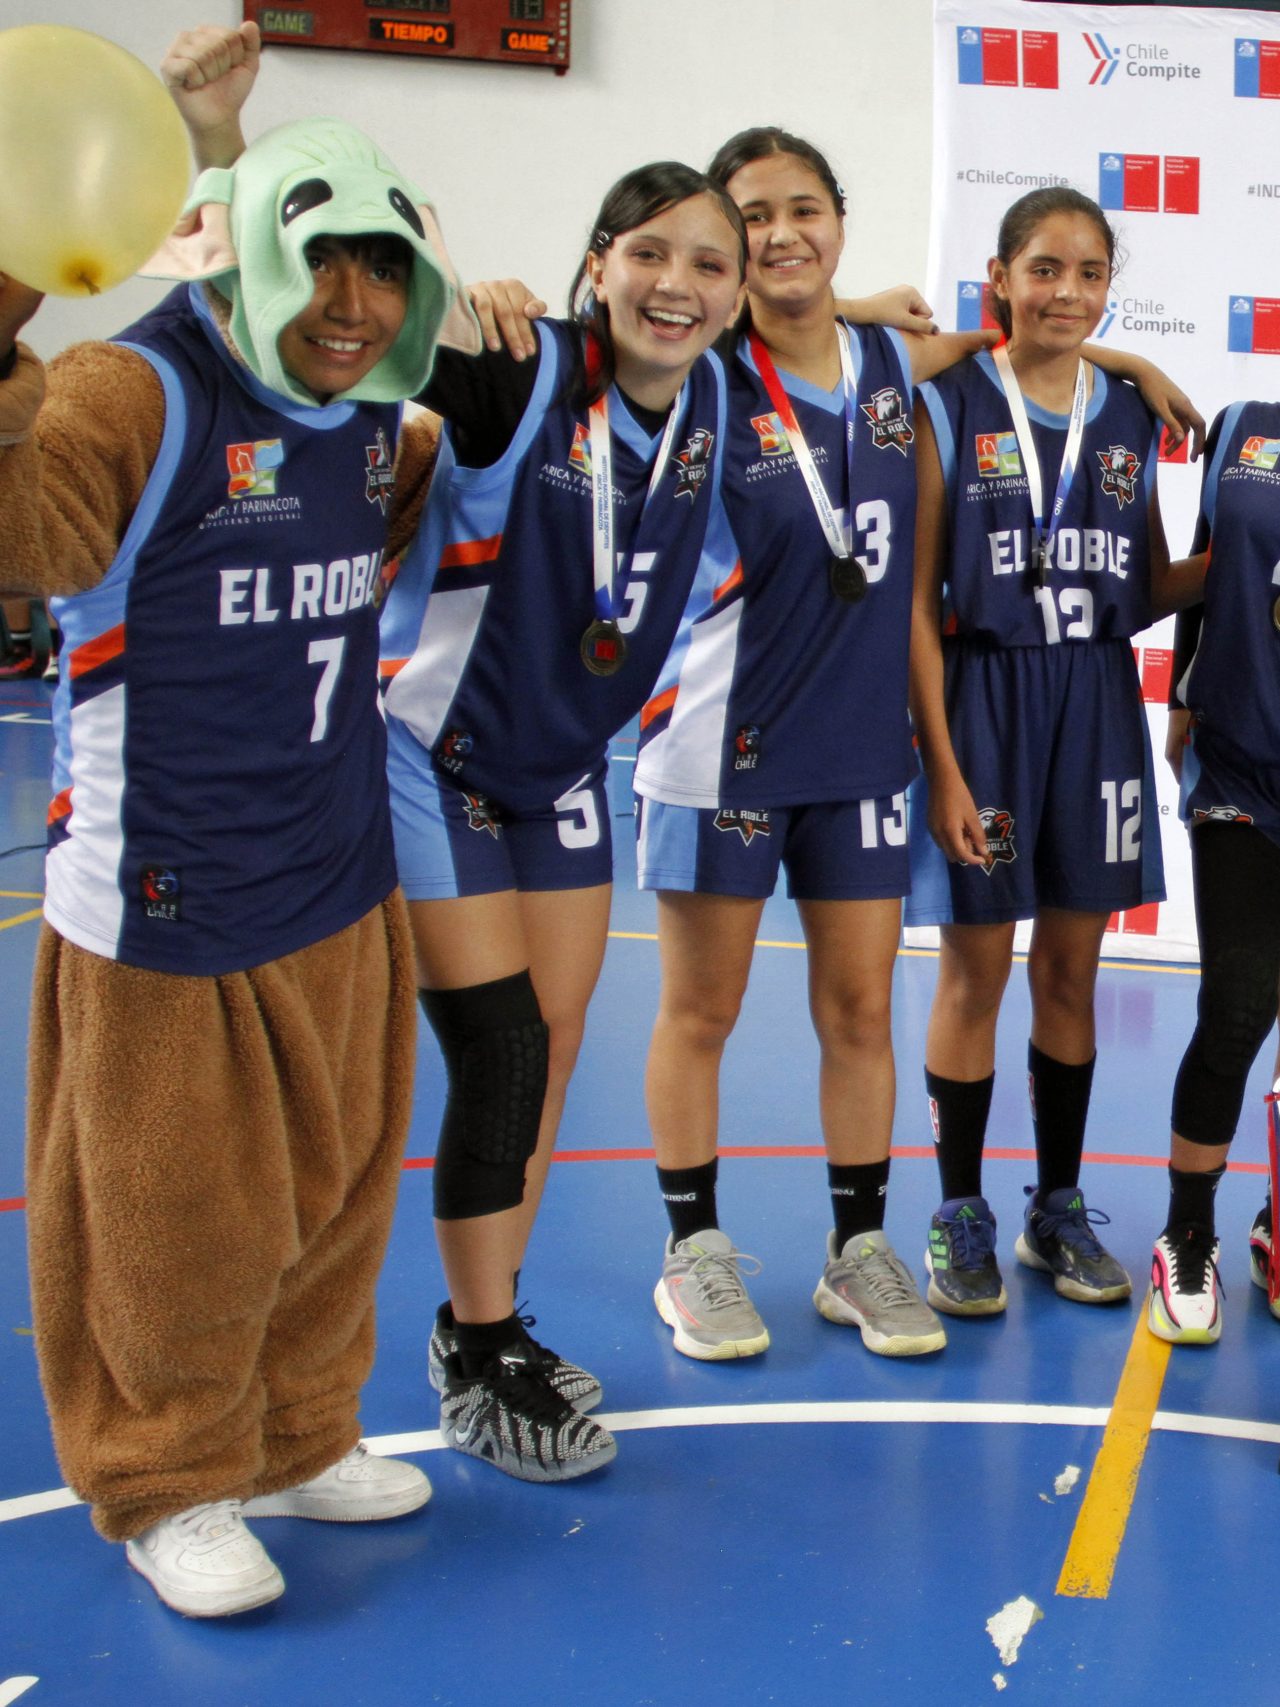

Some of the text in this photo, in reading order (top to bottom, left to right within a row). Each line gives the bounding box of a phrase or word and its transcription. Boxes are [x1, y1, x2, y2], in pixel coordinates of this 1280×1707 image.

[263, 12, 306, 33] GAME
[382, 22, 447, 43] TIEMPO
[508, 33, 549, 50] GAME
[1126, 43, 1169, 61] Chile
[1126, 62, 1201, 81] Compite
[956, 169, 1069, 188] #ChileCompite
[1123, 299, 1165, 315] Chile
[1122, 316, 1196, 336] Compite
[541, 464, 570, 481] ARICA
[745, 461, 769, 475] ARICA
[989, 481, 994, 490] Y
[996, 477, 1028, 490] PARINAC
[242, 497, 300, 514] PARINACOTA
[1055, 497, 1064, 516] IND
[988, 528, 1131, 580] EL ROBLE
[219, 548, 384, 625] EL ROBL
[616, 552, 657, 634] 5
[307, 636, 346, 743] 7
[734, 759, 757, 770] CHILE
[722, 810, 736, 818] EL
[860, 792, 907, 849] 13
[1101, 779, 1142, 863] 12
[984, 842, 1009, 851] OBLE
